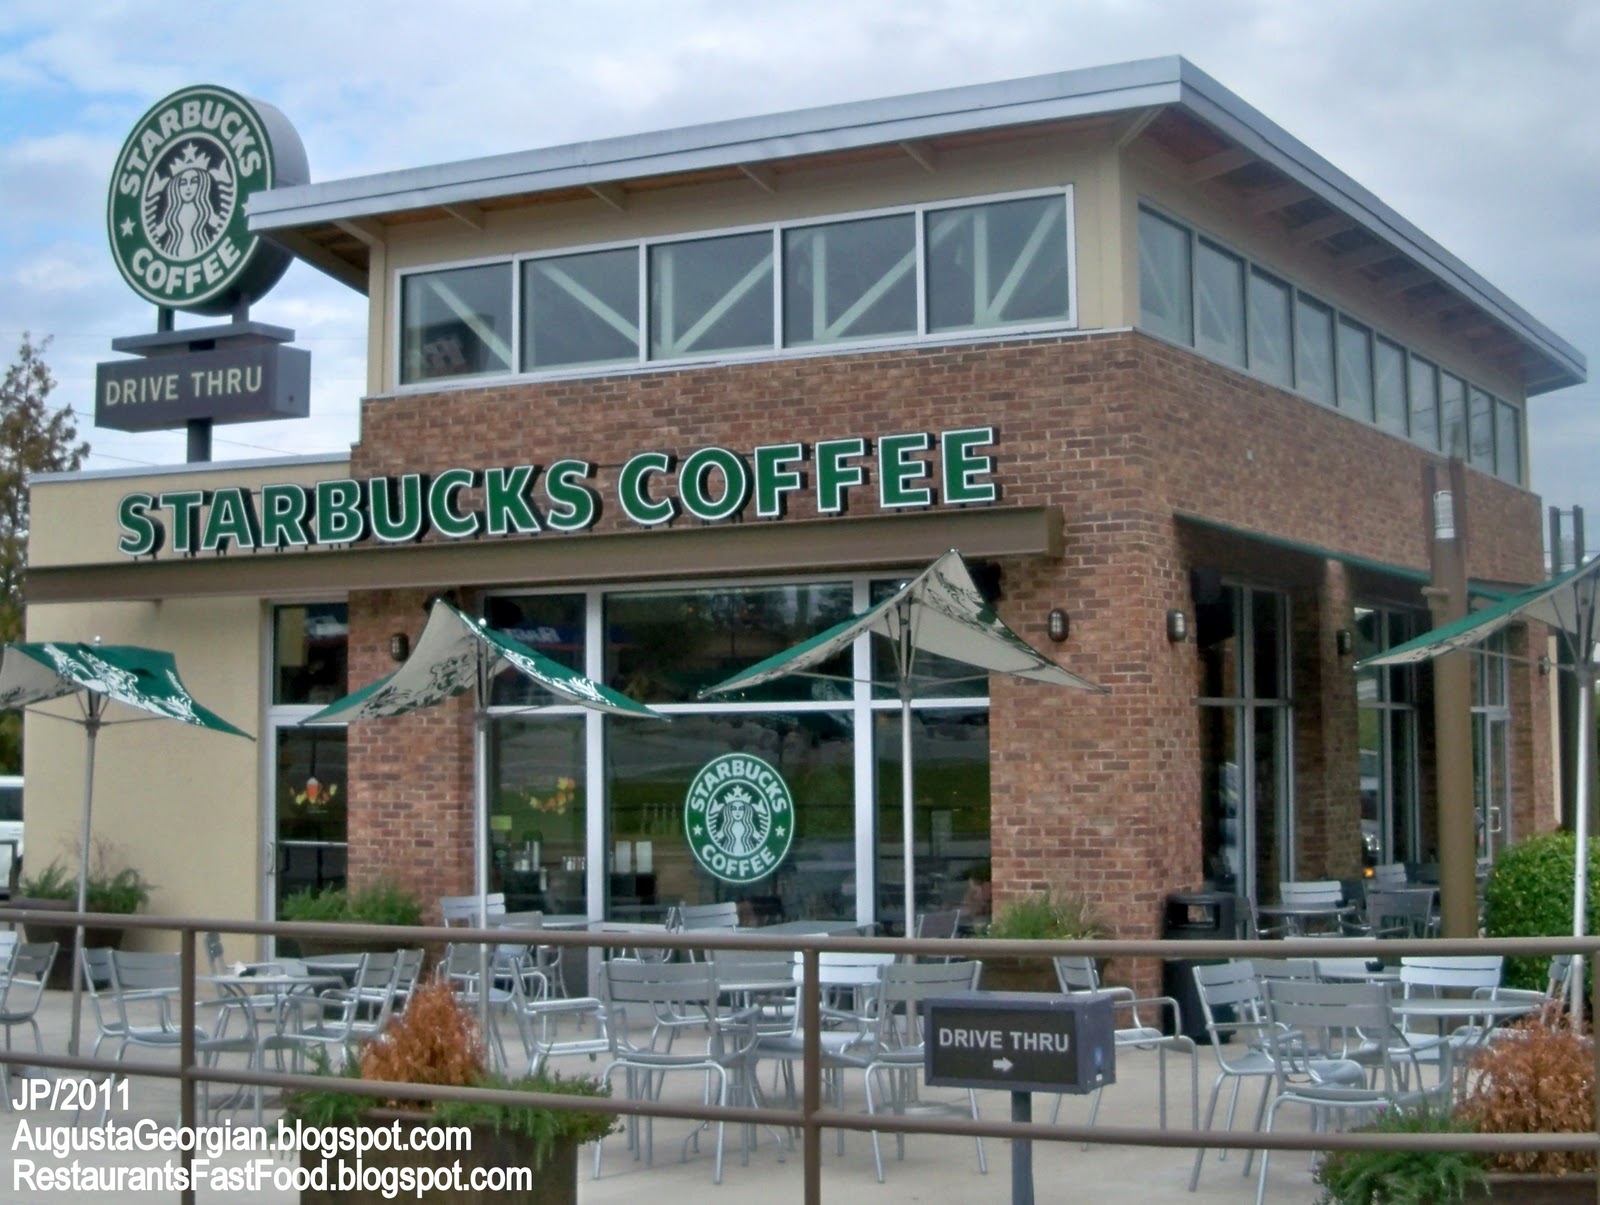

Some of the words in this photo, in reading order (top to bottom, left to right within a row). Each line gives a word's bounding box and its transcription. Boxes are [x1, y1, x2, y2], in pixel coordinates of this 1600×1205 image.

[120, 99, 262, 198] STARBUCKS
[131, 235, 241, 295] COFFEE
[105, 373, 180, 406] DRIVE
[191, 366, 263, 398] THRU
[118, 458, 597, 556] STARBUCKS
[618, 425, 997, 526] COFFEE
[690, 759, 788, 814] STARBUCKS
[701, 844, 776, 877] COFFEE
[938, 1027, 1003, 1049] DRIVE
[1009, 1030, 1070, 1052] THRU
